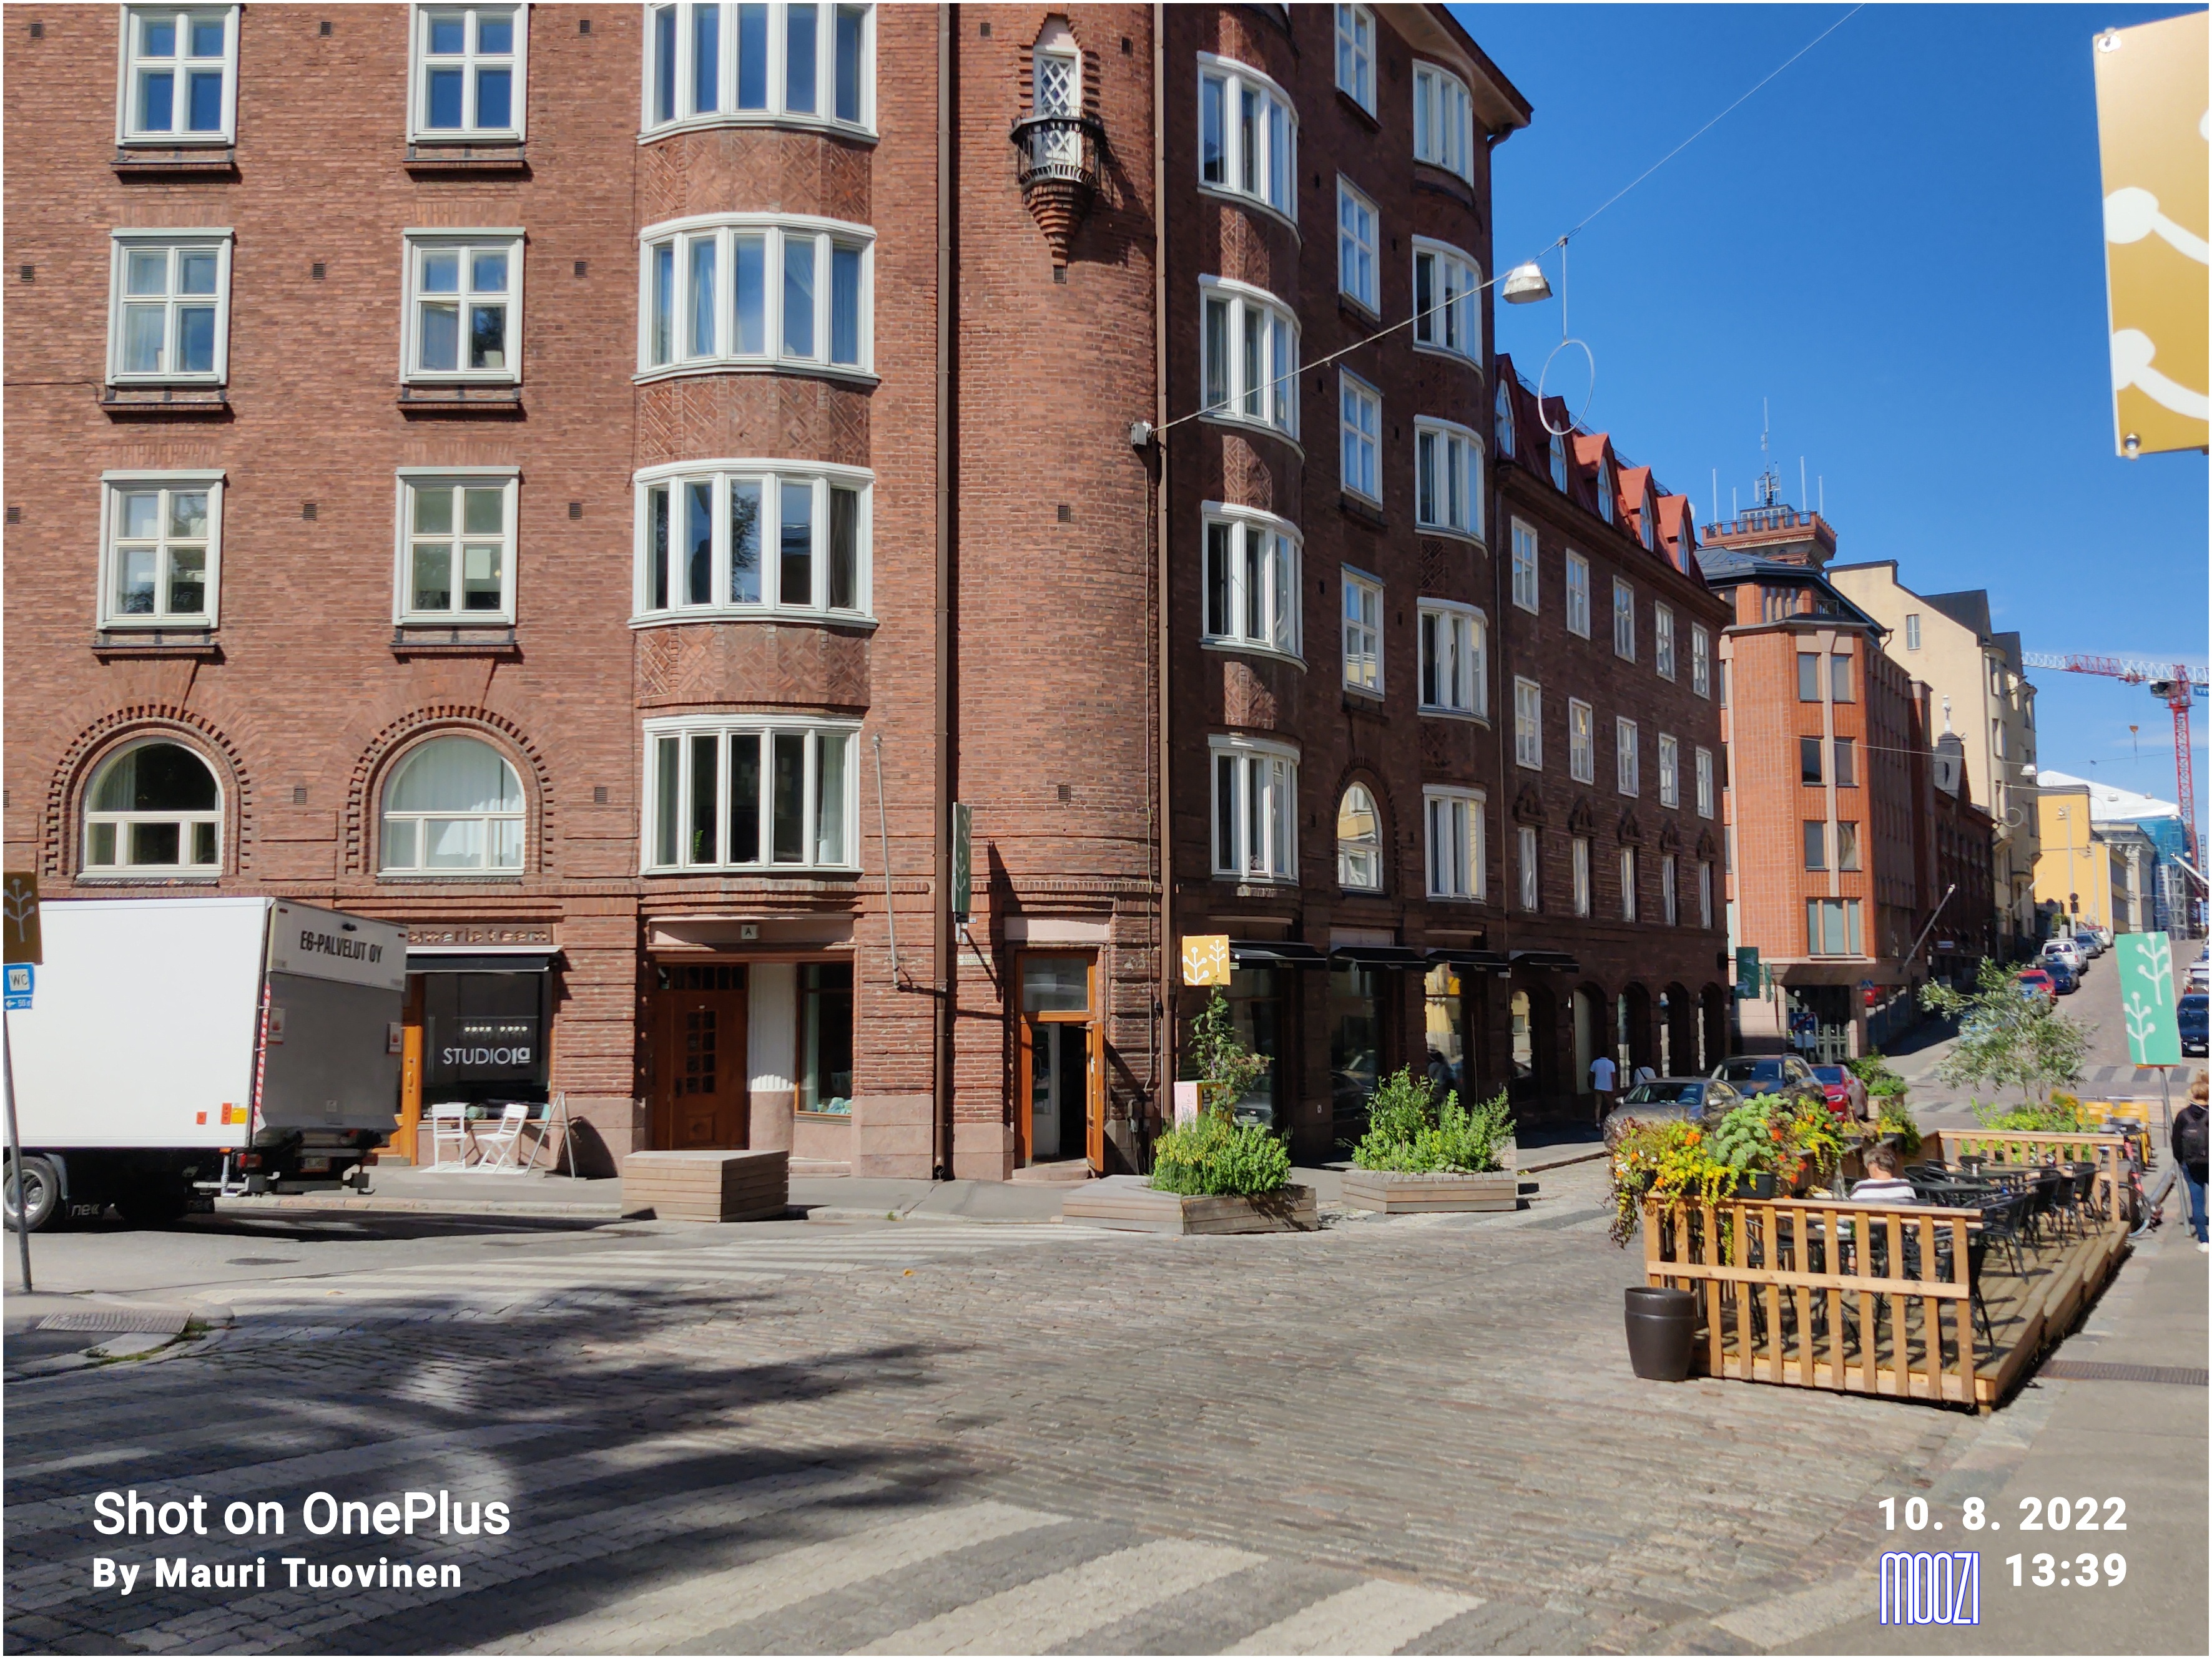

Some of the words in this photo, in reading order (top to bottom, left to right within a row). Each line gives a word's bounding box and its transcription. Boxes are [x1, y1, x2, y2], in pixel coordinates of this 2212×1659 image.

[744, 927, 753, 936] A
[369, 944, 383, 964] OY
[10, 974, 28, 986] WC
